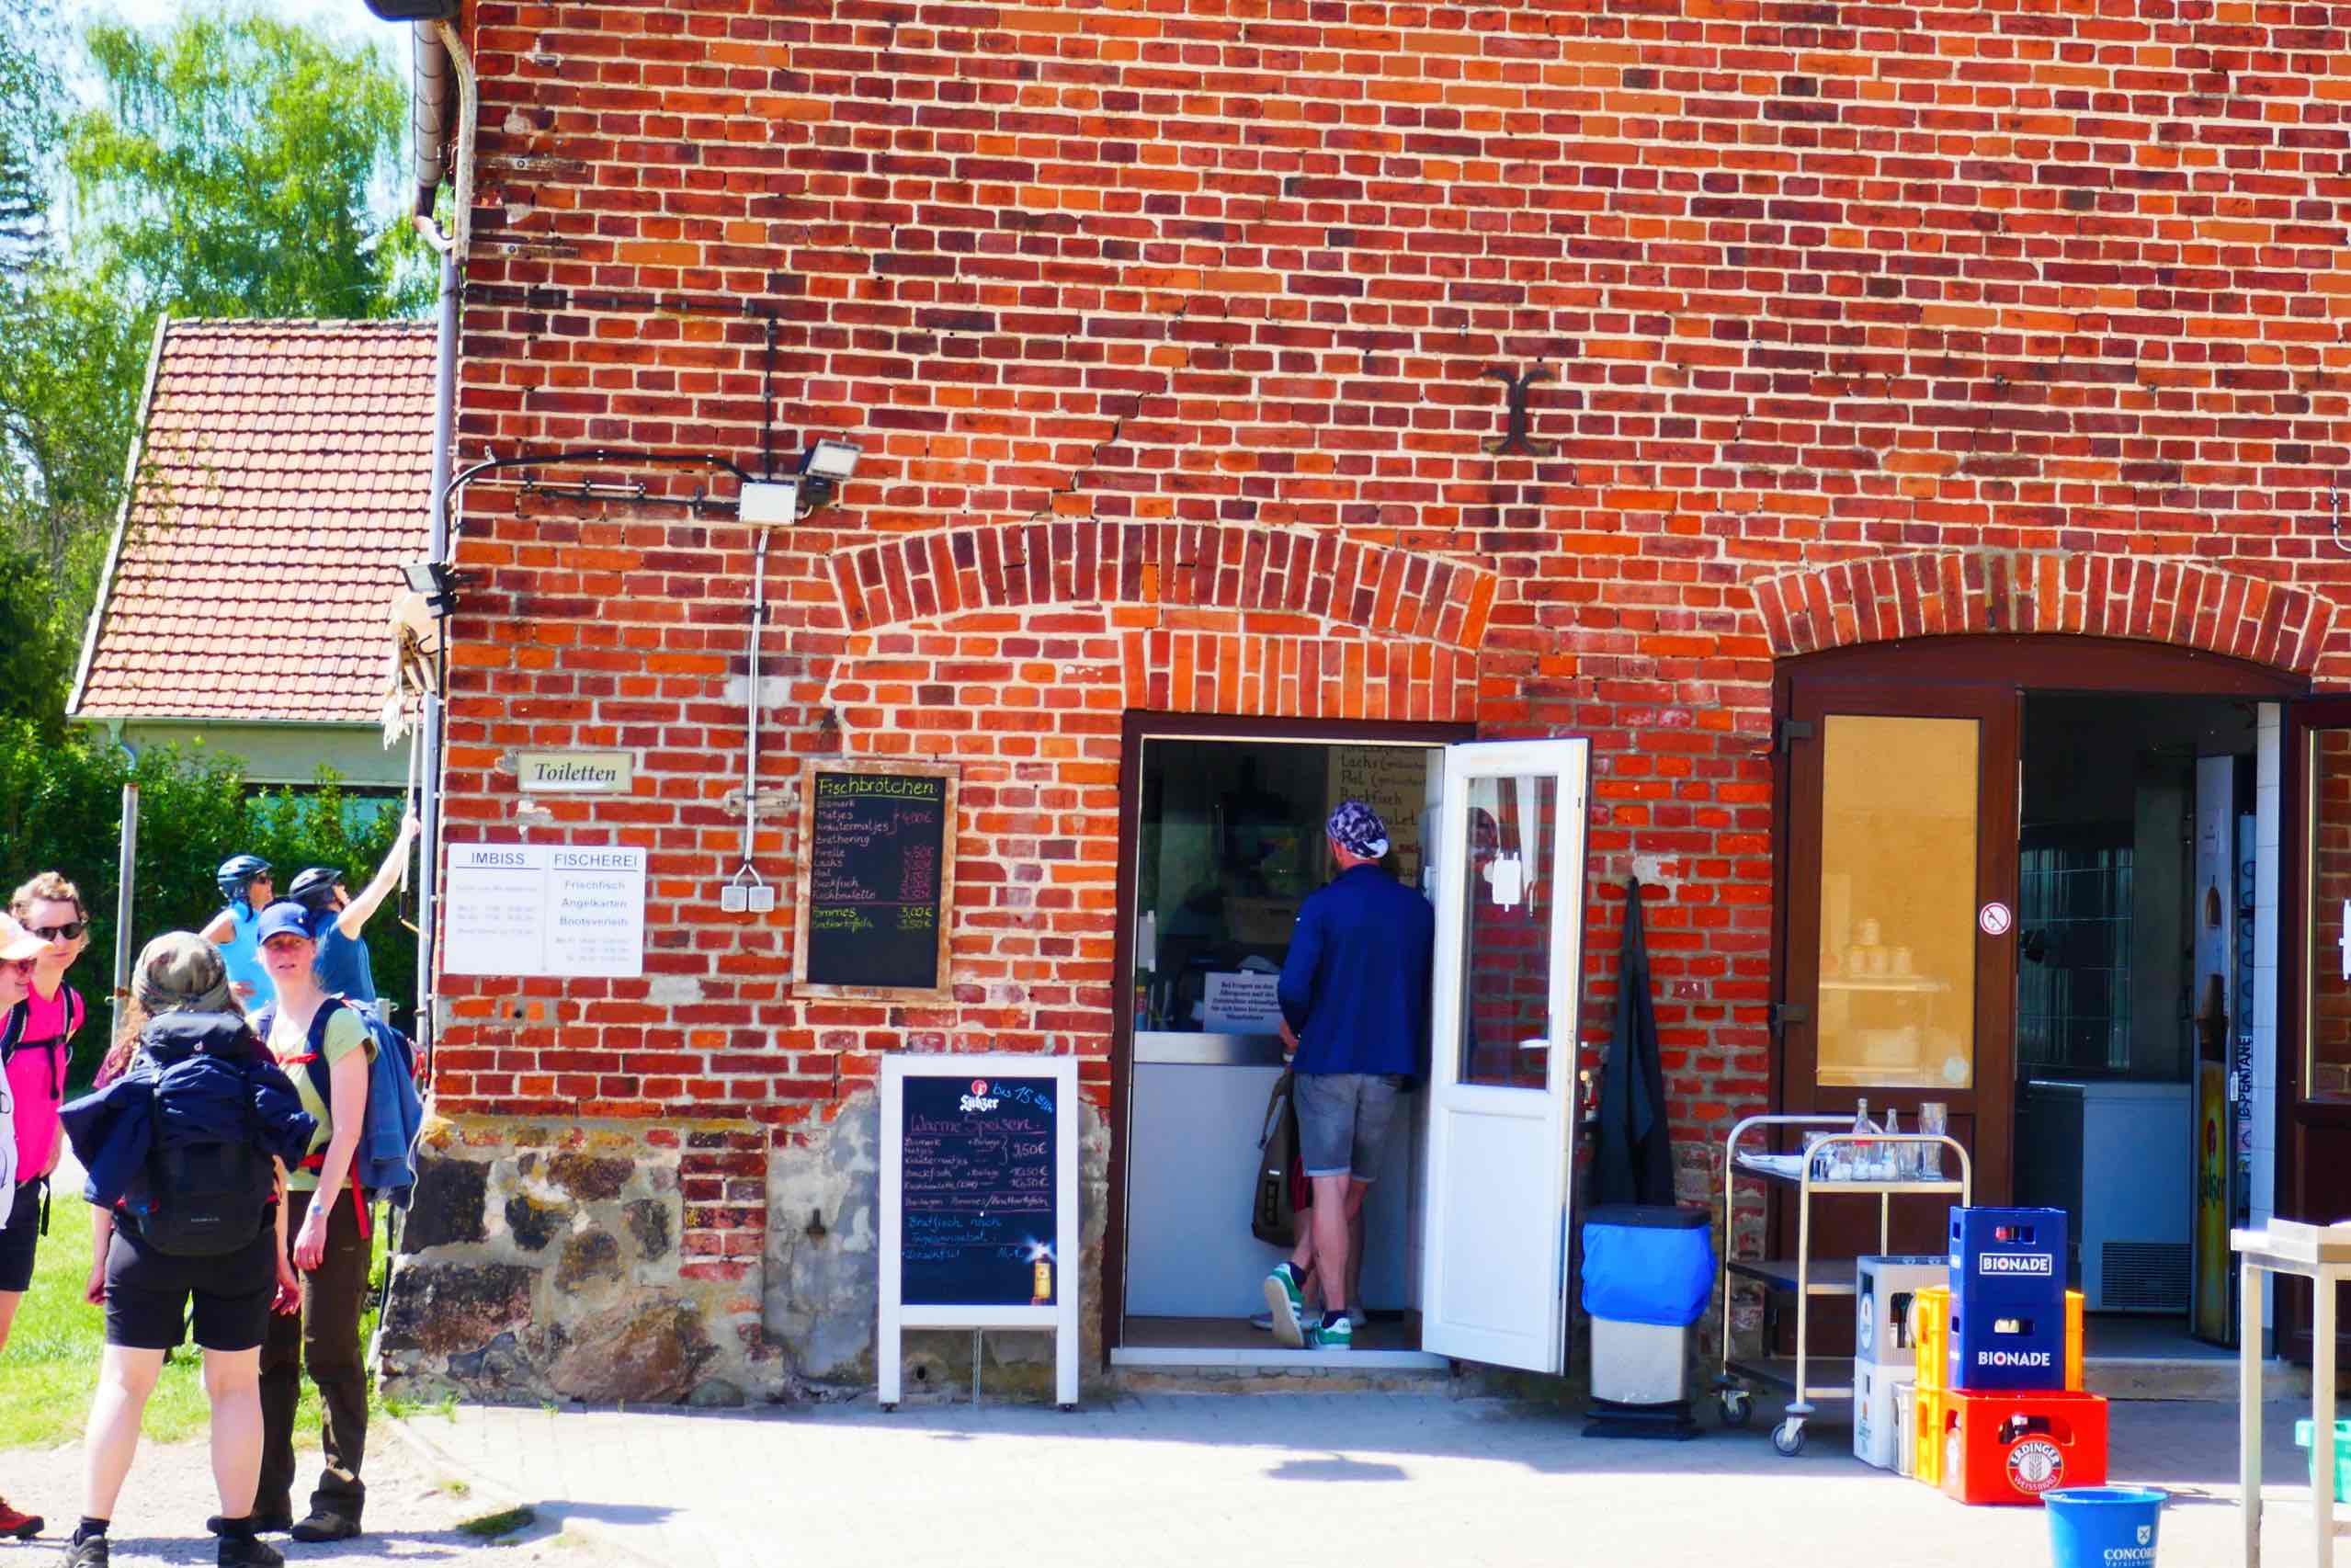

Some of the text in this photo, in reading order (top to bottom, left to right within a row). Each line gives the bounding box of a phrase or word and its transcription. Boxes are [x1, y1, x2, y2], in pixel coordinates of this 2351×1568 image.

[535, 763, 617, 781] Toiletten
[817, 811, 854, 822] Matjes
[471, 852, 525, 866] IMBISS
[553, 853, 638, 868] FISCHEREI
[564, 880, 625, 891] Frischfisch
[562, 898, 627, 910] Angelkarten
[1015, 1086, 1034, 1103] 15
[1983, 1257, 2048, 1271] BIONADE
[1978, 1351, 2050, 1367] BIONADE
[2011, 1442, 2060, 1464] ERDINGER
